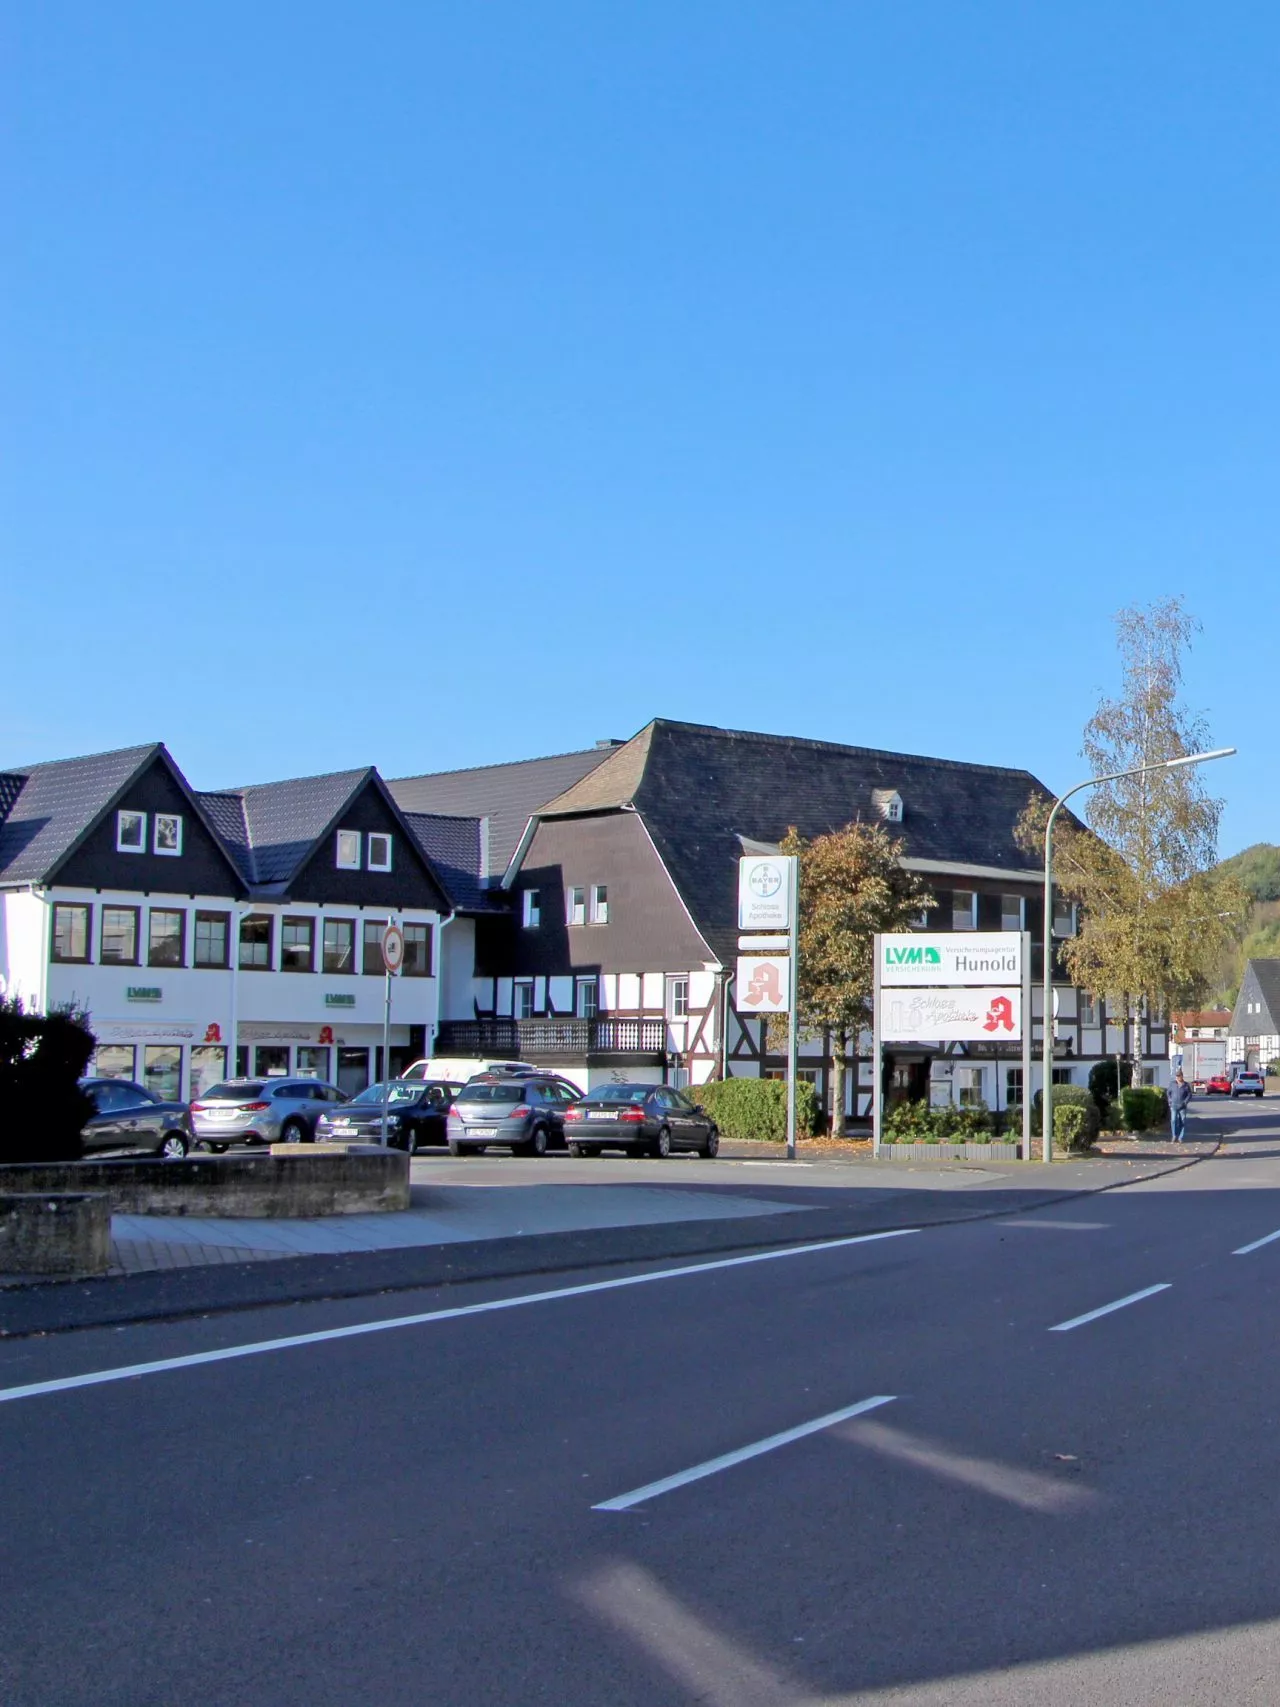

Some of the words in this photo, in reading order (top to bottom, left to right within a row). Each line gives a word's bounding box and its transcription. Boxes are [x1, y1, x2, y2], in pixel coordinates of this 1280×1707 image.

[886, 947, 923, 964] LVM
[946, 946, 1015, 955] Versicherungsagentur
[956, 955, 1016, 971] Hunold
